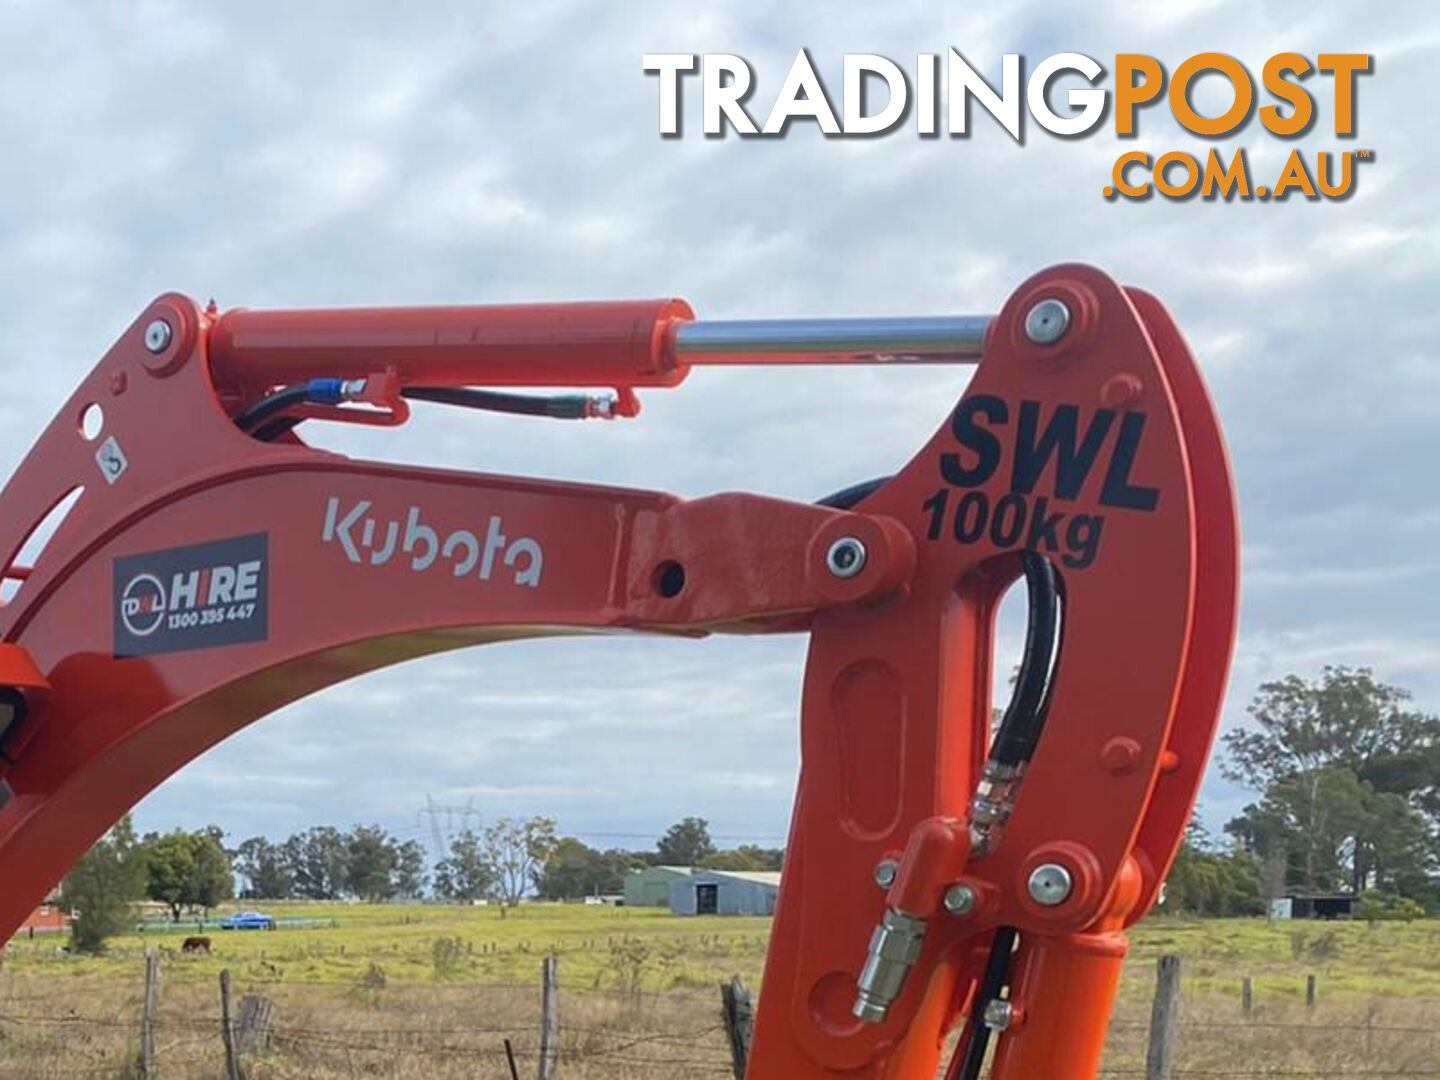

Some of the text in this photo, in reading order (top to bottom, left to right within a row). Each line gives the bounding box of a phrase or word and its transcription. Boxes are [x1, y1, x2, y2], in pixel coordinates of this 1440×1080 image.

[939, 394, 1160, 512] SWL
[322, 498, 543, 587] Kubota
[922, 488, 1105, 570] 100kg
[168, 611, 199, 630] 1300
[227, 603, 256, 620] 447
[169, 560, 261, 612] HIRE
